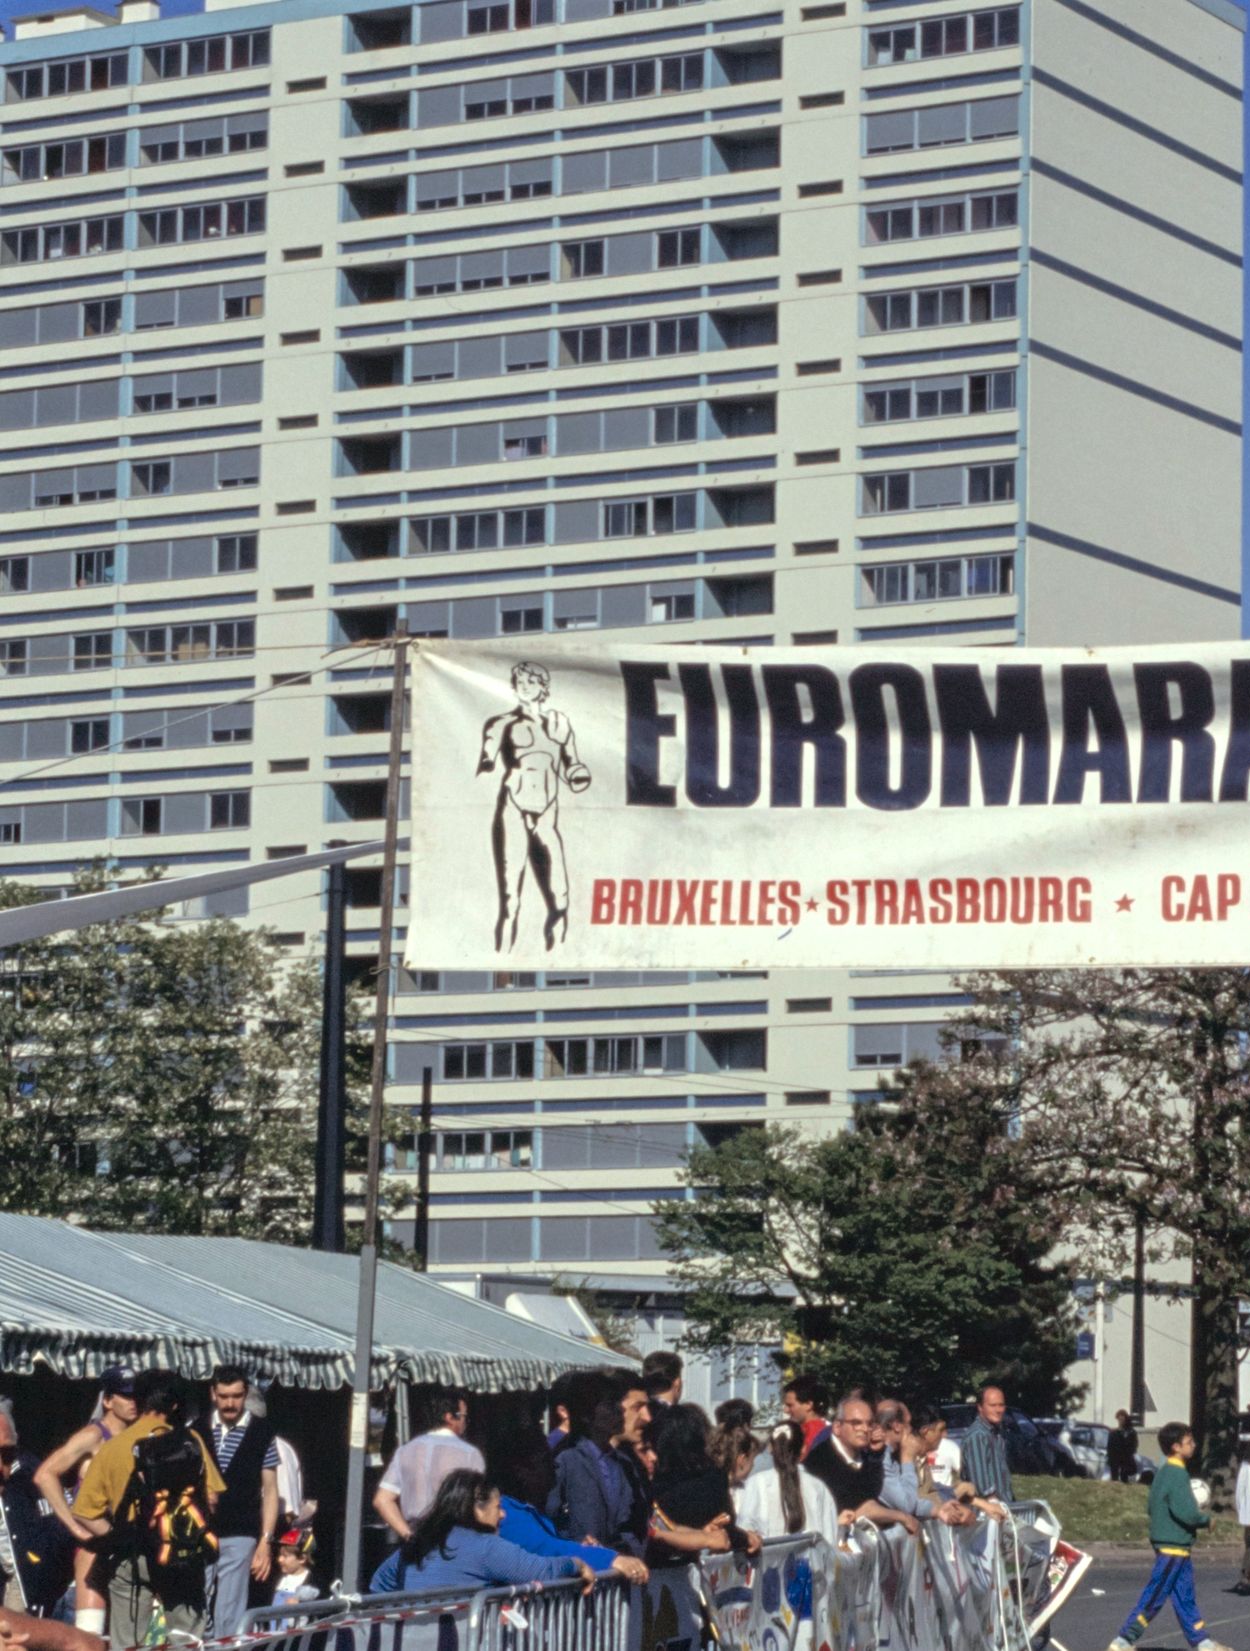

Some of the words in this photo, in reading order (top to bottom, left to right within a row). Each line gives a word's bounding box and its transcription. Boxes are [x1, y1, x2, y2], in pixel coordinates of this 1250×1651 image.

[591, 879, 802, 925] BRUXELLES
[826, 876, 1092, 925] STRASBOURG
[1161, 874, 1241, 922] CAP
